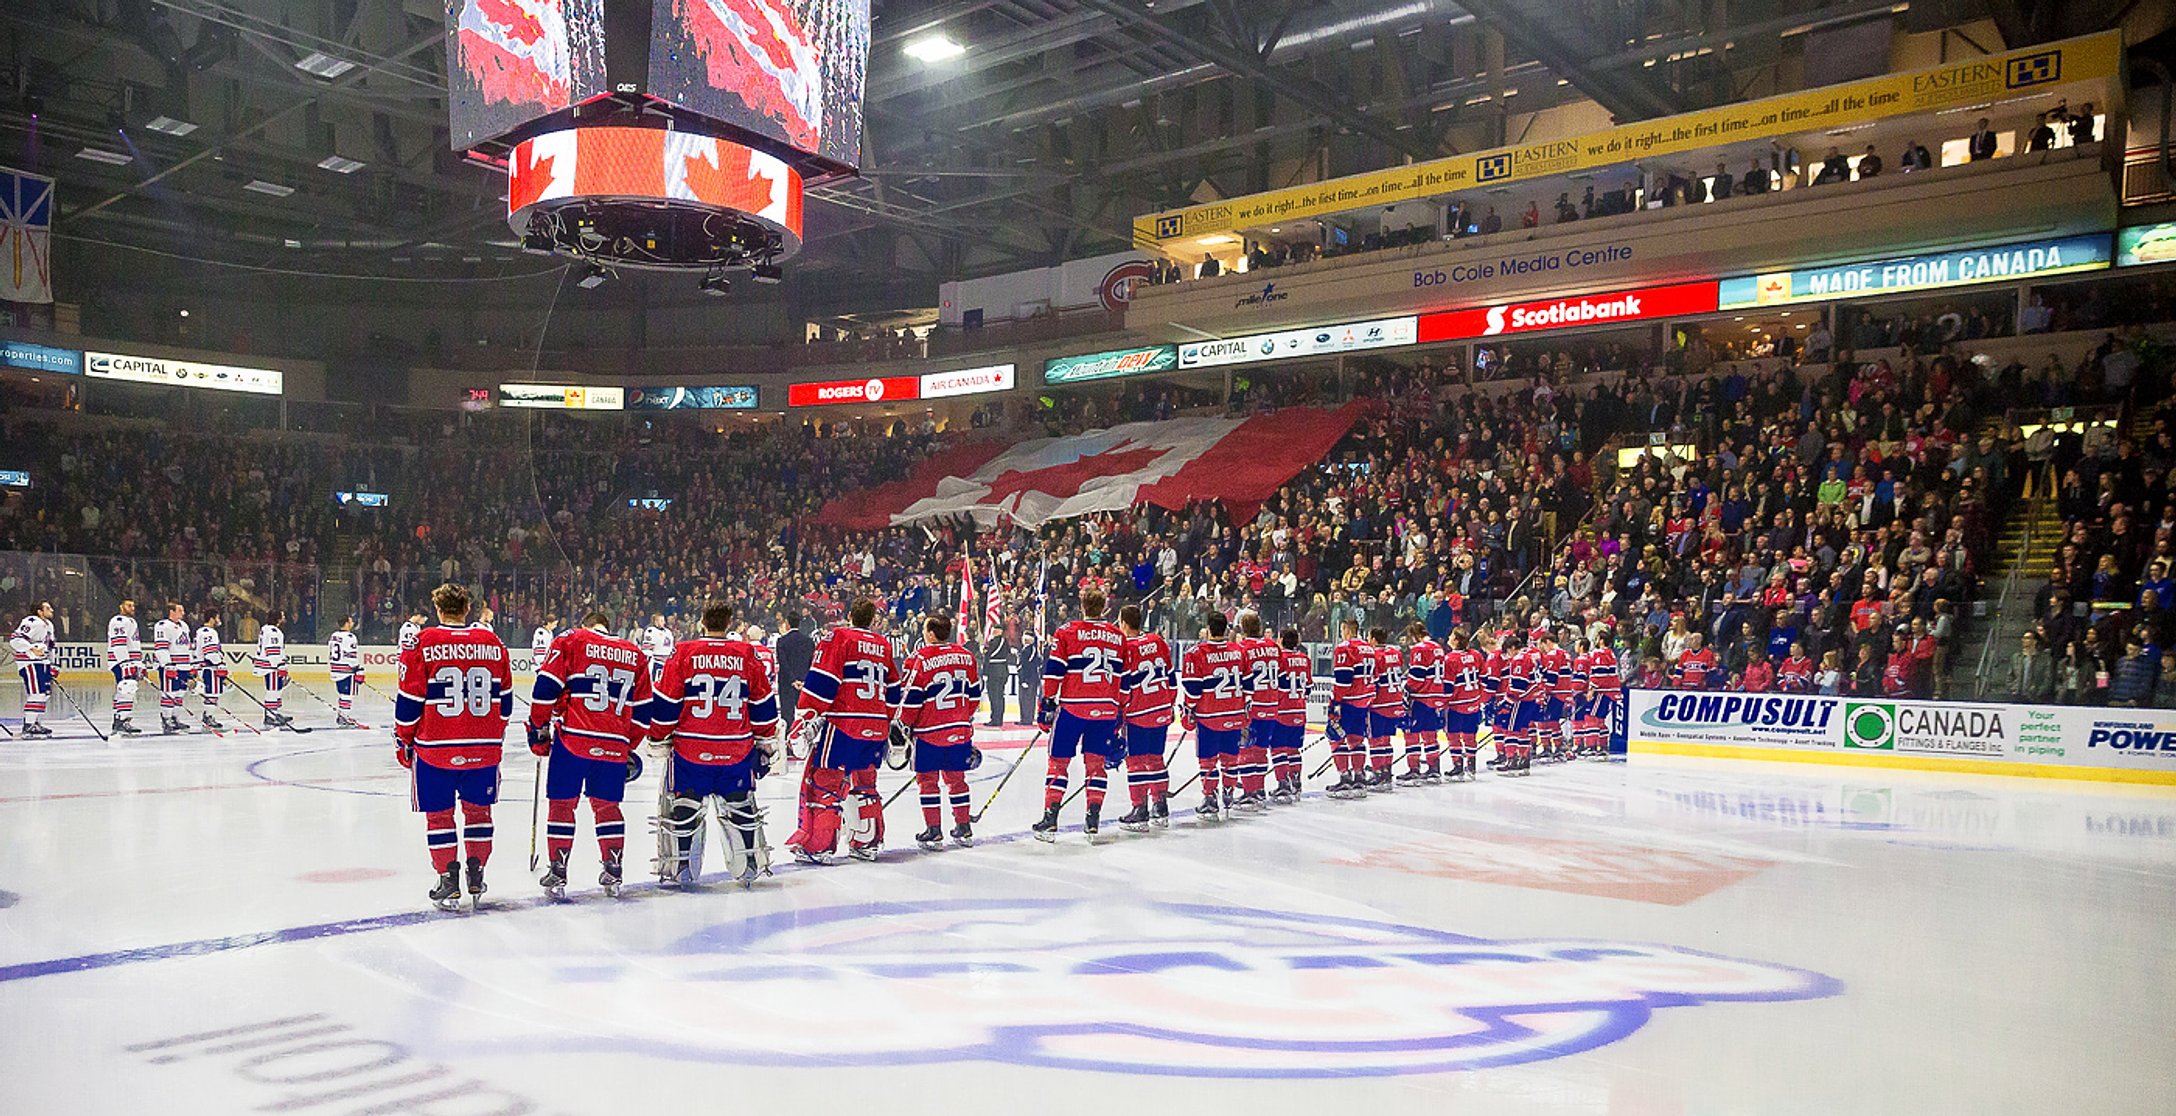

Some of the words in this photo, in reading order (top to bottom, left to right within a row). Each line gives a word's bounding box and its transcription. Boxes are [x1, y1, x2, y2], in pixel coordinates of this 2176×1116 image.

[1913, 63, 2002, 92] EASTERN
[1607, 139, 1621, 154] do
[1869, 91, 1900, 107] time
[1514, 139, 1578, 164] EASTERN
[1184, 205, 1233, 225] EASTERN
[1414, 270, 1447, 287] Bob
[1452, 264, 1494, 283] Cole
[1500, 255, 1560, 276] Media
[1565, 246, 1632, 267] Centre
[1809, 268, 1873, 295] MADE
[1882, 260, 1950, 288] FROM
[1959, 246, 2063, 281] CANADA
[1512, 295, 1641, 328] Scotiabank
[1201, 341, 1247, 357] CAPITAL
[113, 359, 169, 375] CAPITAL
[818, 385, 864, 399] ROGERS
[868, 385, 882, 395] TV
[930, 381, 947, 391] AIR
[948, 375, 990, 389] CANADA
[422, 645, 501, 662] EISENSCHMID
[586, 643, 638, 667] GREGOIRE
[692, 655, 744, 671] TOKARSKI
[1082, 646, 1118, 684] 25
[856, 659, 886, 701] 31
[1213, 665, 1243, 699] 21
[1252, 660, 1279, 691] 20
[435, 666, 493, 717] 38
[584, 664, 636, 716] 37
[691, 673, 743, 720] 34
[1658, 694, 1838, 727] COMPUSULT
[1899, 709, 2005, 739] CANADA
[2028, 710, 2055, 720] Your
[2019, 735, 2061, 744] partner
[2020, 722, 2061, 733] perfect
[1898, 737, 1935, 749] FITTINGS
[1938, 740, 1944, 749] &
[1946, 740, 1986, 751] FLANGES
[2028, 746, 2065, 757] piping
